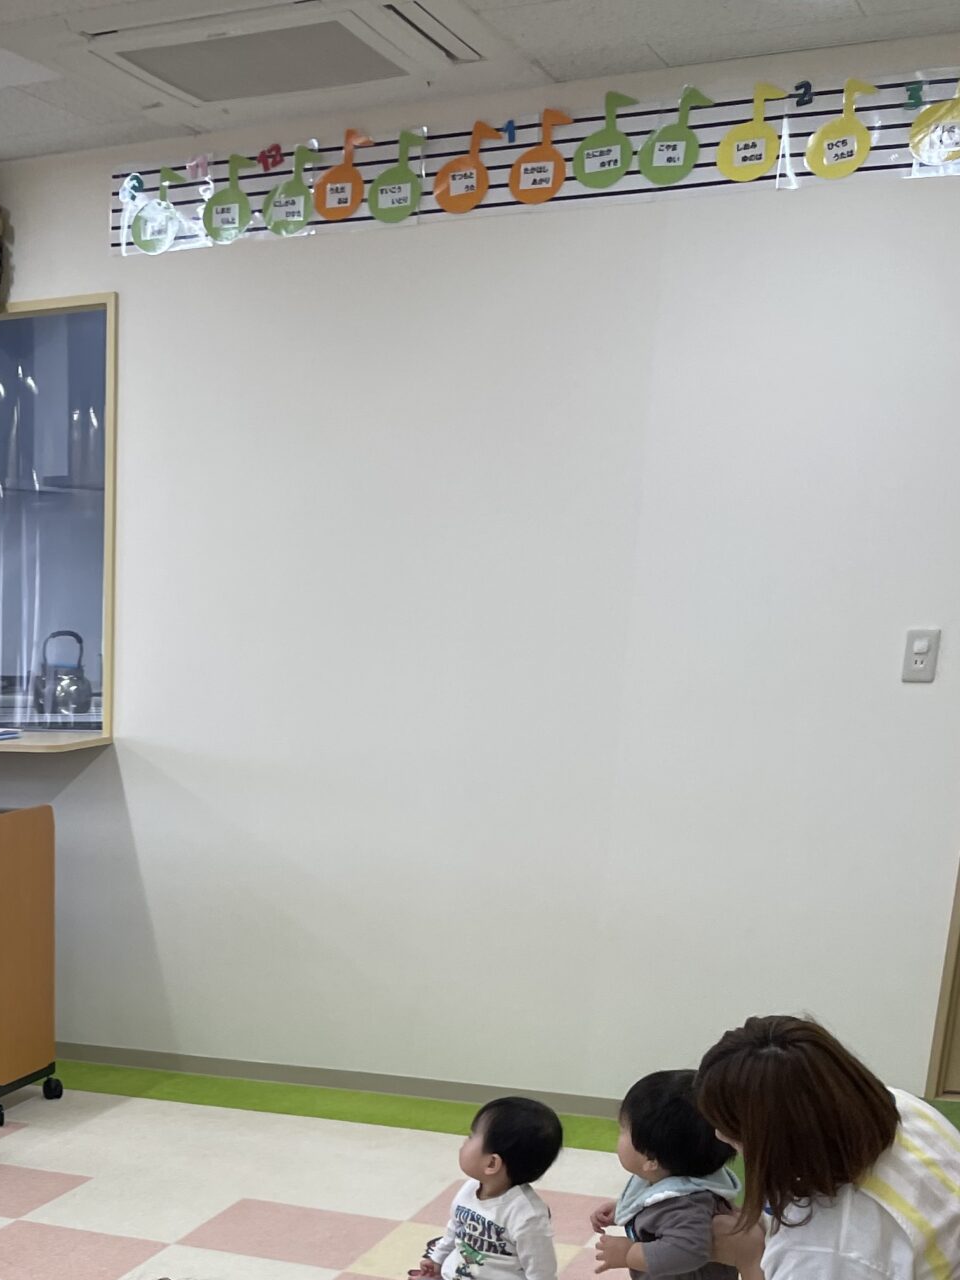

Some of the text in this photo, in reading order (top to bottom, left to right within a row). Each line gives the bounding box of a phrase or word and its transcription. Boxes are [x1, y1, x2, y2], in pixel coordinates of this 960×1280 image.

[795, 80, 813, 107] 2
[503, 119, 516, 143] 1
[257, 143, 284, 172] 12
